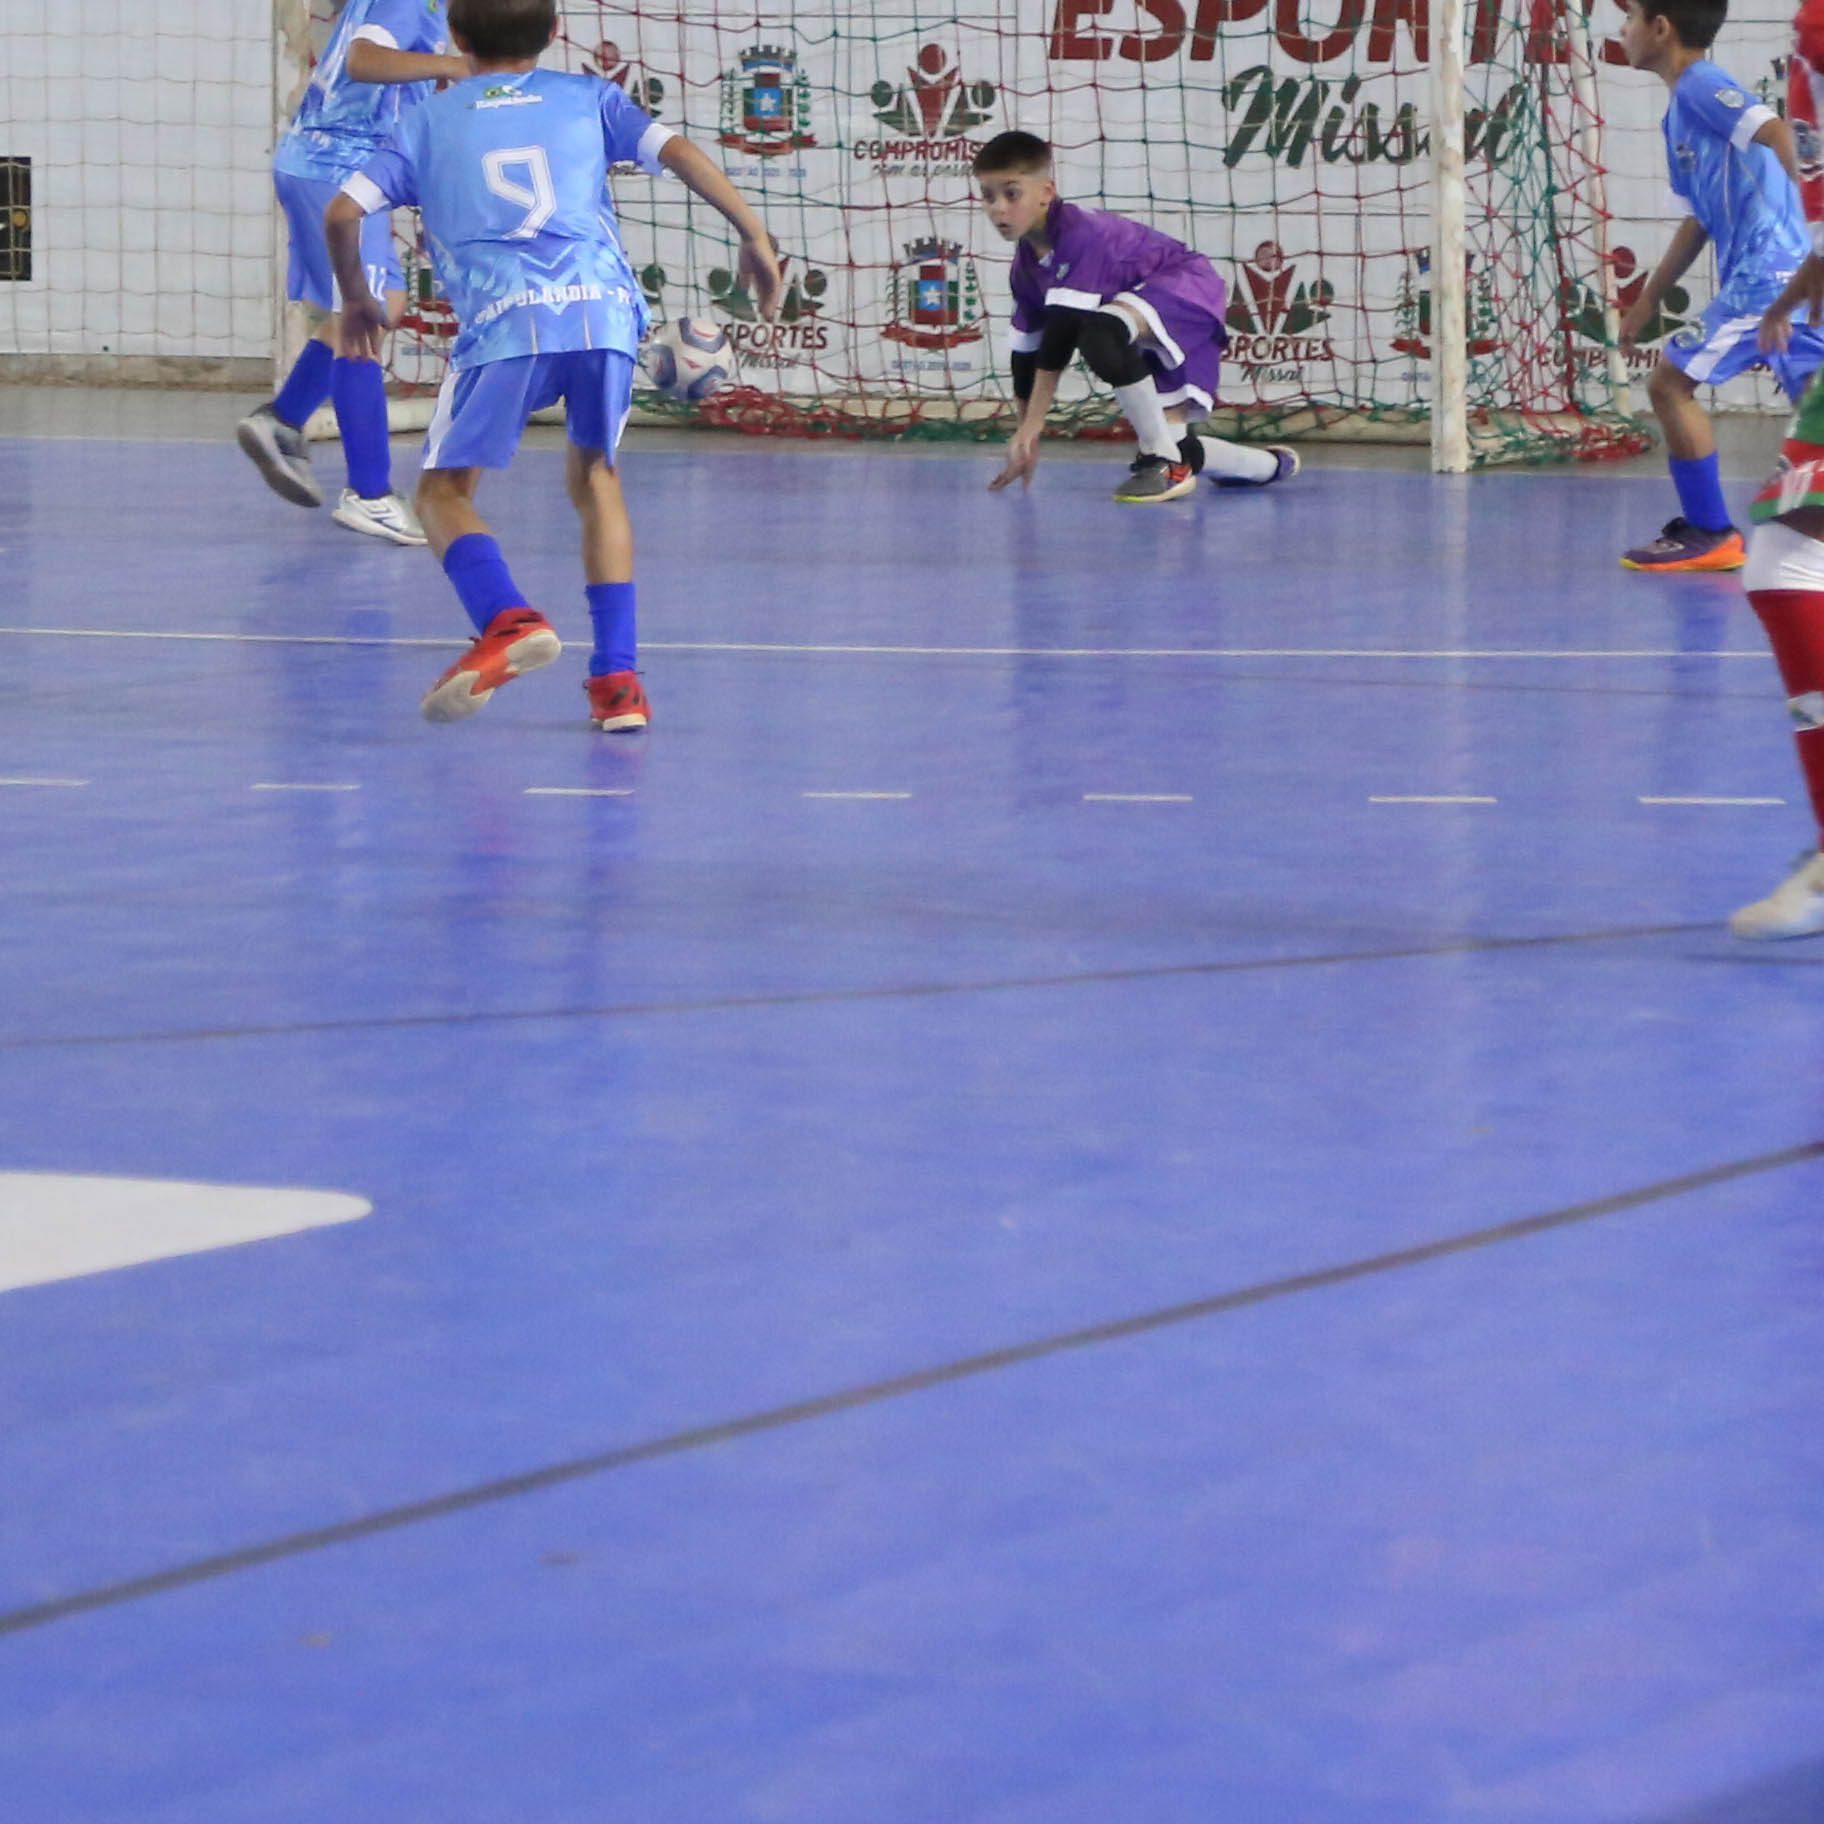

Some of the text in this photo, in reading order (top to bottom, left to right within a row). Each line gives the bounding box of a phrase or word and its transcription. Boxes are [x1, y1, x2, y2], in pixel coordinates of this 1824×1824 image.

[853, 139, 986, 161] COMPROMIS
[482, 145, 557, 239] 9
[723, 323, 828, 350] SPORTES
[1222, 336, 1335, 362] SPORTES
